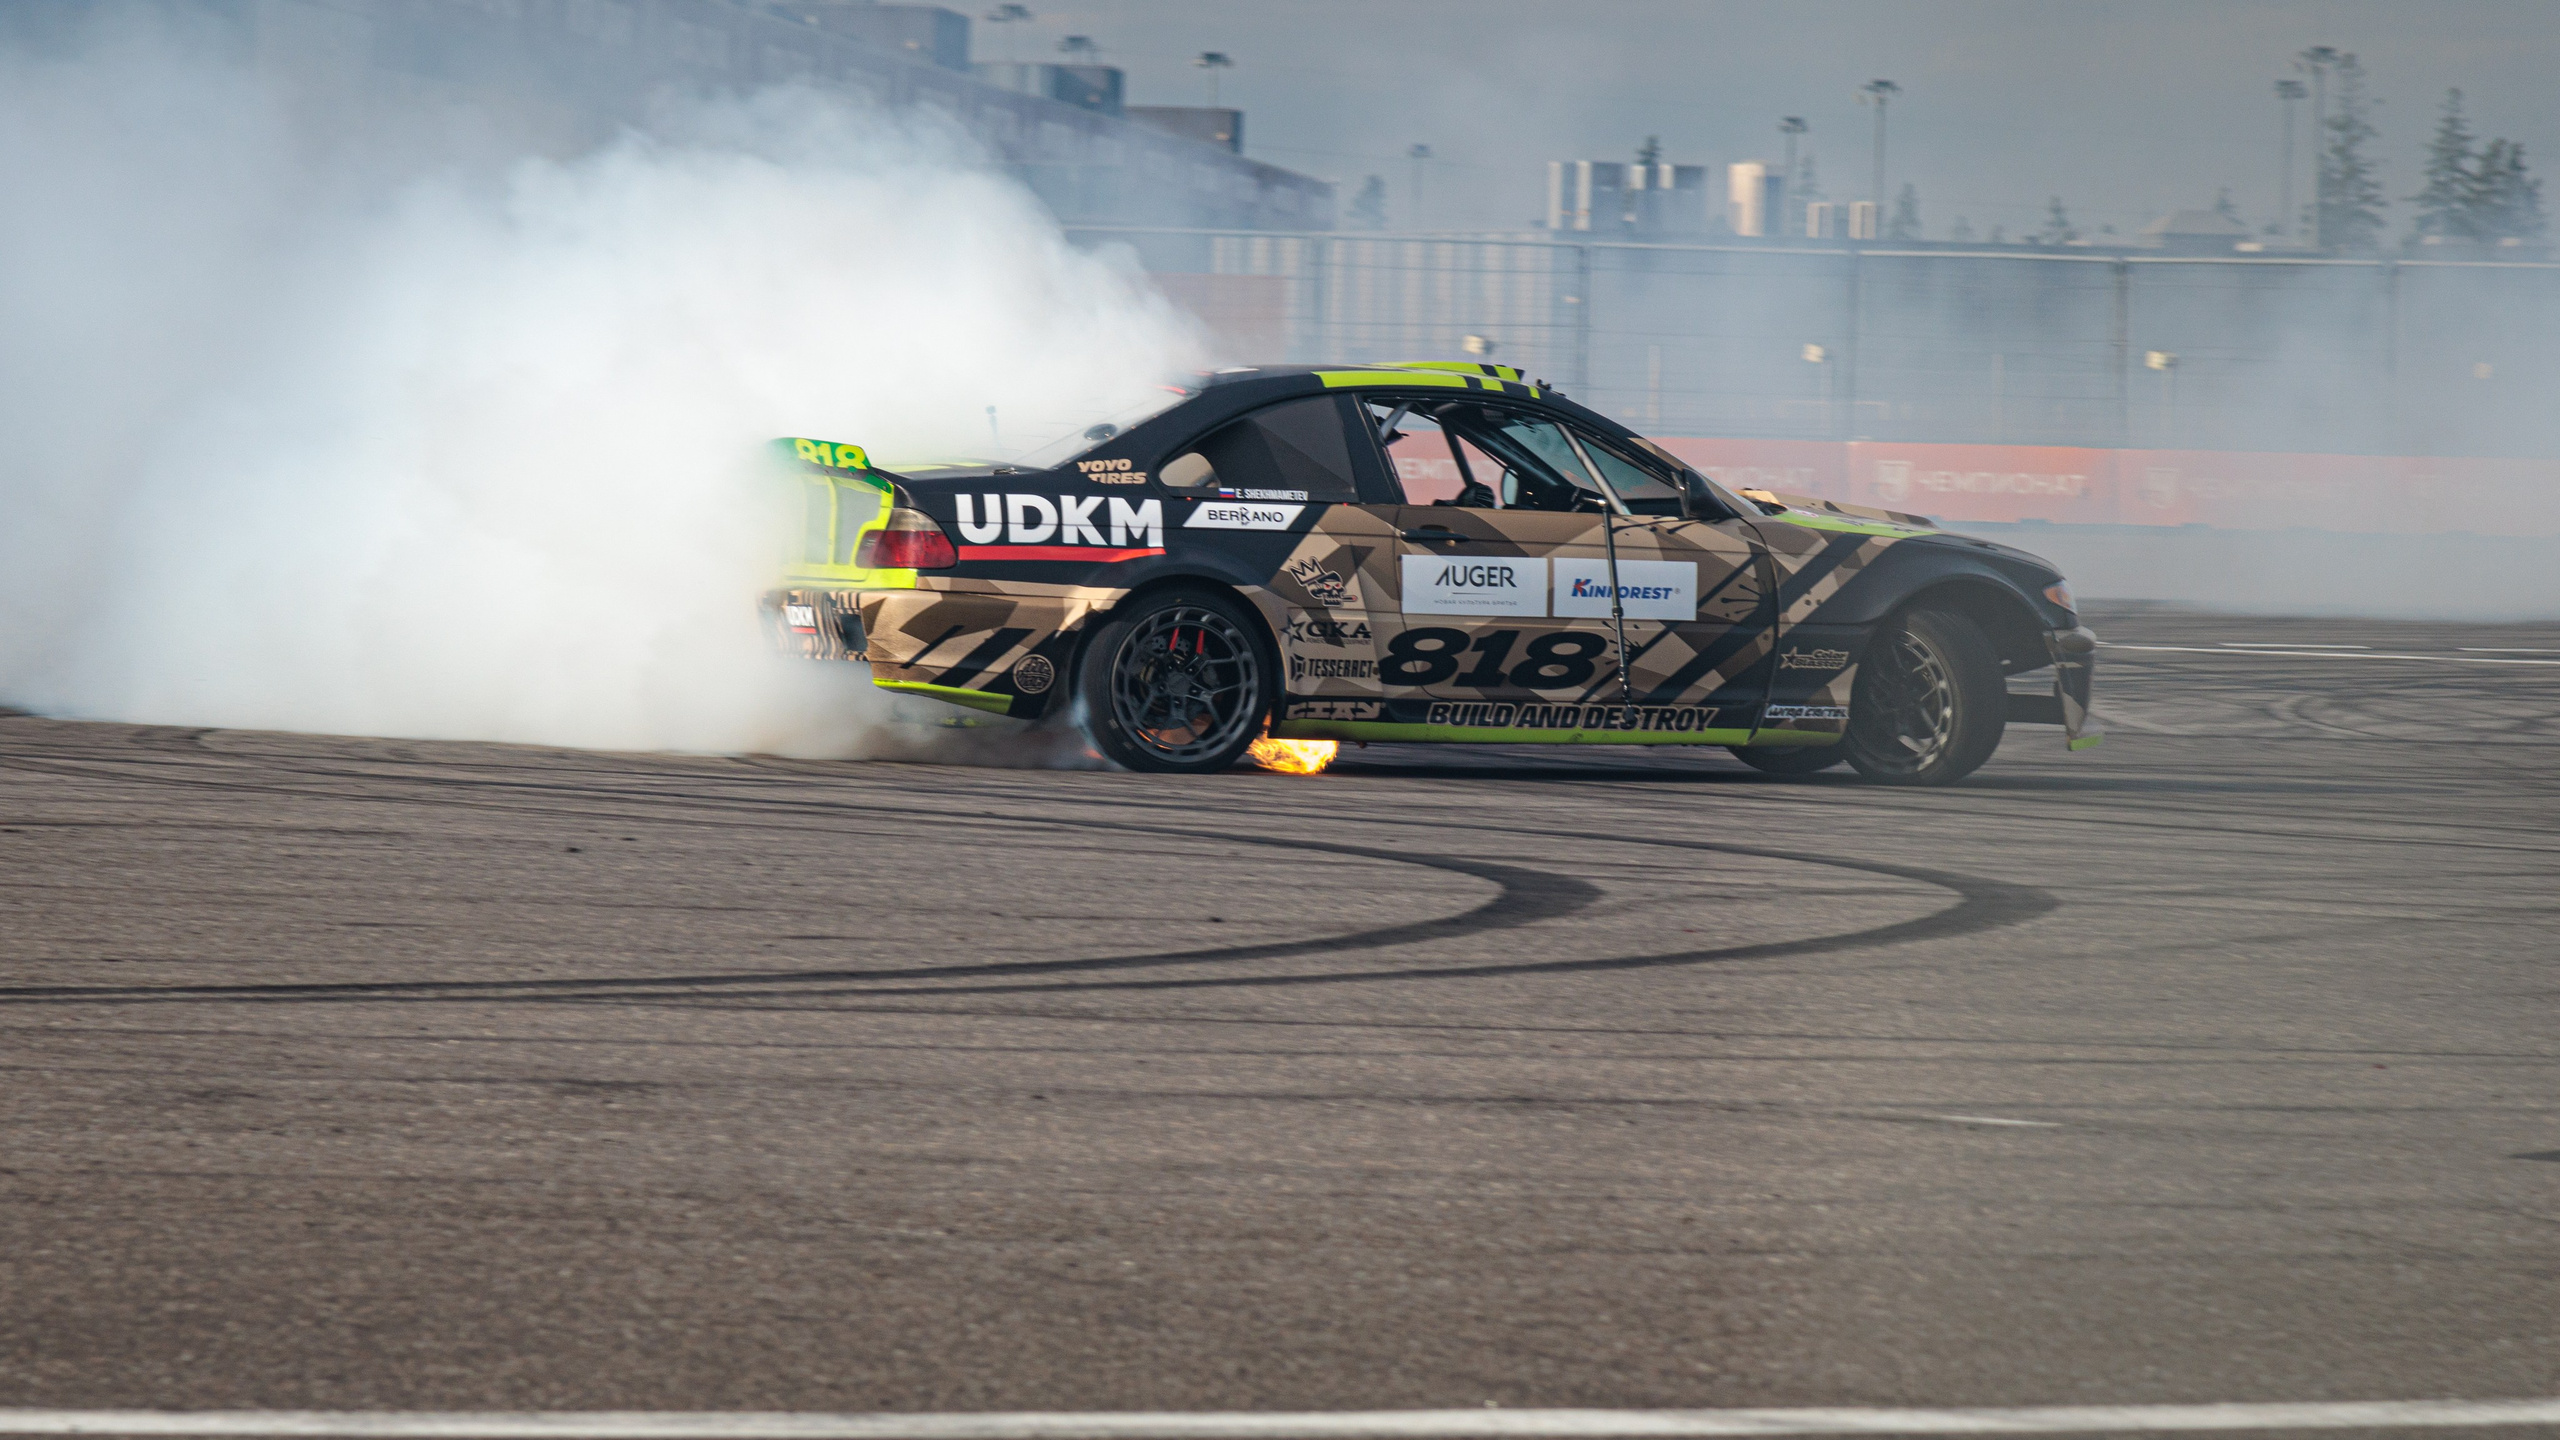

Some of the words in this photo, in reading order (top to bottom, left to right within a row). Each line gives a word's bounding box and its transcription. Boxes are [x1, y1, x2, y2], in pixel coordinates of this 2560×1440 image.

[1077, 458, 1132, 473] YOYO
[1088, 472, 1147, 485] TIRES
[1235, 488, 1245, 499] E.
[955, 493, 1164, 547] UDKM
[1207, 507, 1284, 524] BERKANO
[1434, 565, 1517, 588] AUGER
[1571, 578, 1672, 599] KINOREST
[1306, 621, 1371, 638] GKA
[1378, 627, 1607, 690] 818
[1308, 659, 1374, 678] TESSERACT
[1427, 702, 1515, 728] BUILD
[1513, 703, 1583, 730] AND
[1580, 704, 1719, 732] DESTROY
